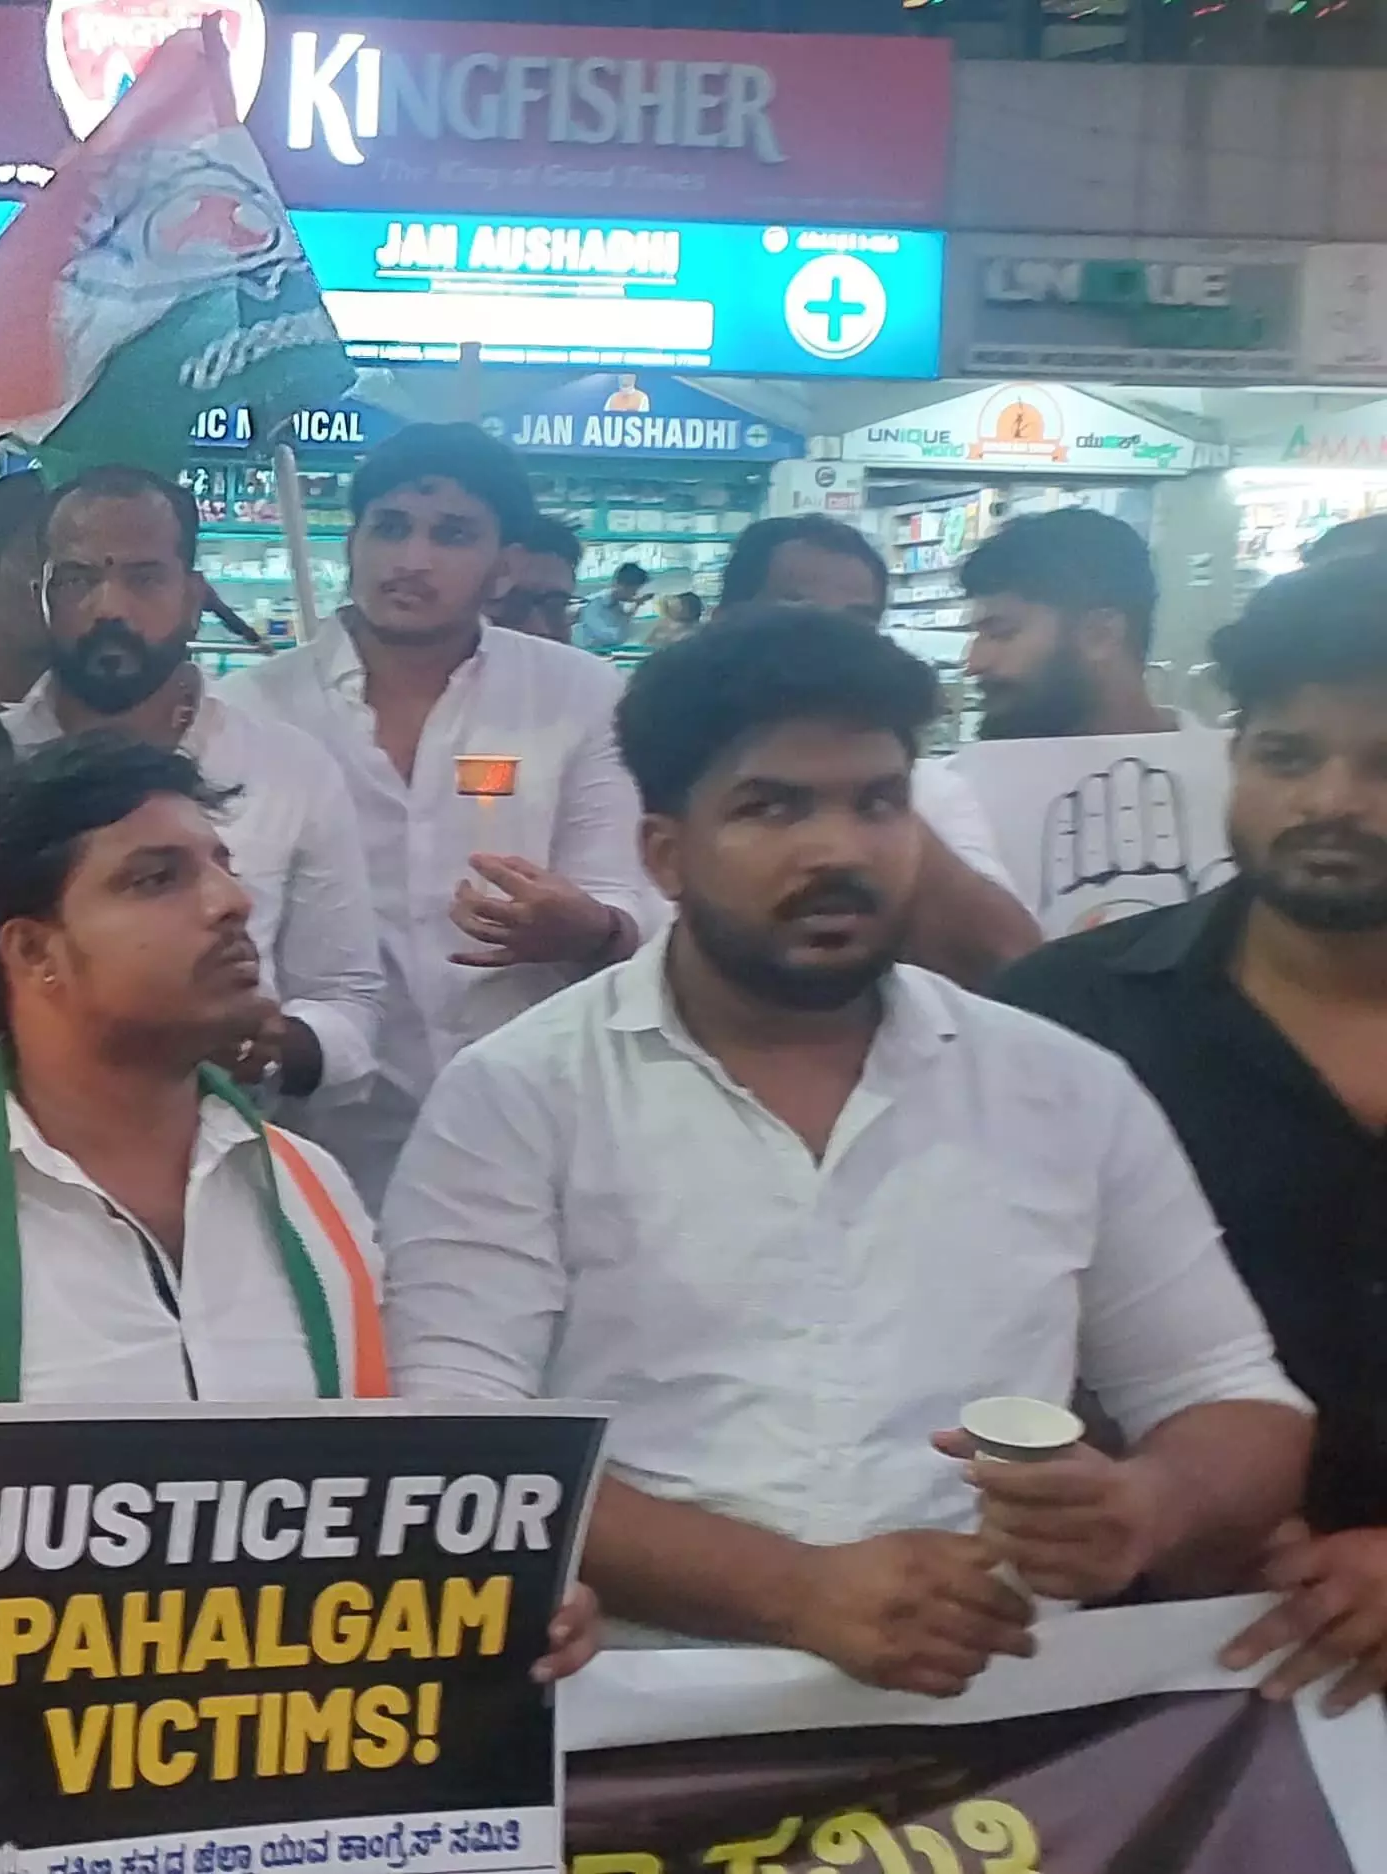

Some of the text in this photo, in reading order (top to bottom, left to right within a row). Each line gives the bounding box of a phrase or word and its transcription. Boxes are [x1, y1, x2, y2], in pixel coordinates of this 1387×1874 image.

[287, 31, 790, 165] KINGFISHER
[375, 221, 681, 275] JAN AUSHADHI
[513, 413, 741, 450] JAN AUSHADHI
[867, 428, 952, 446] UNIQUE
[377, 1474, 564, 1557] FOR
[42, 1681, 445, 1796] VICTIMS!
[260, 1829, 329, 1868] ಯುವ
[337, 1820, 443, 1869] ಕಾಂಗ್ರೆಸ್
[448, 1818, 521, 1855] ಸಮಿತಿ
